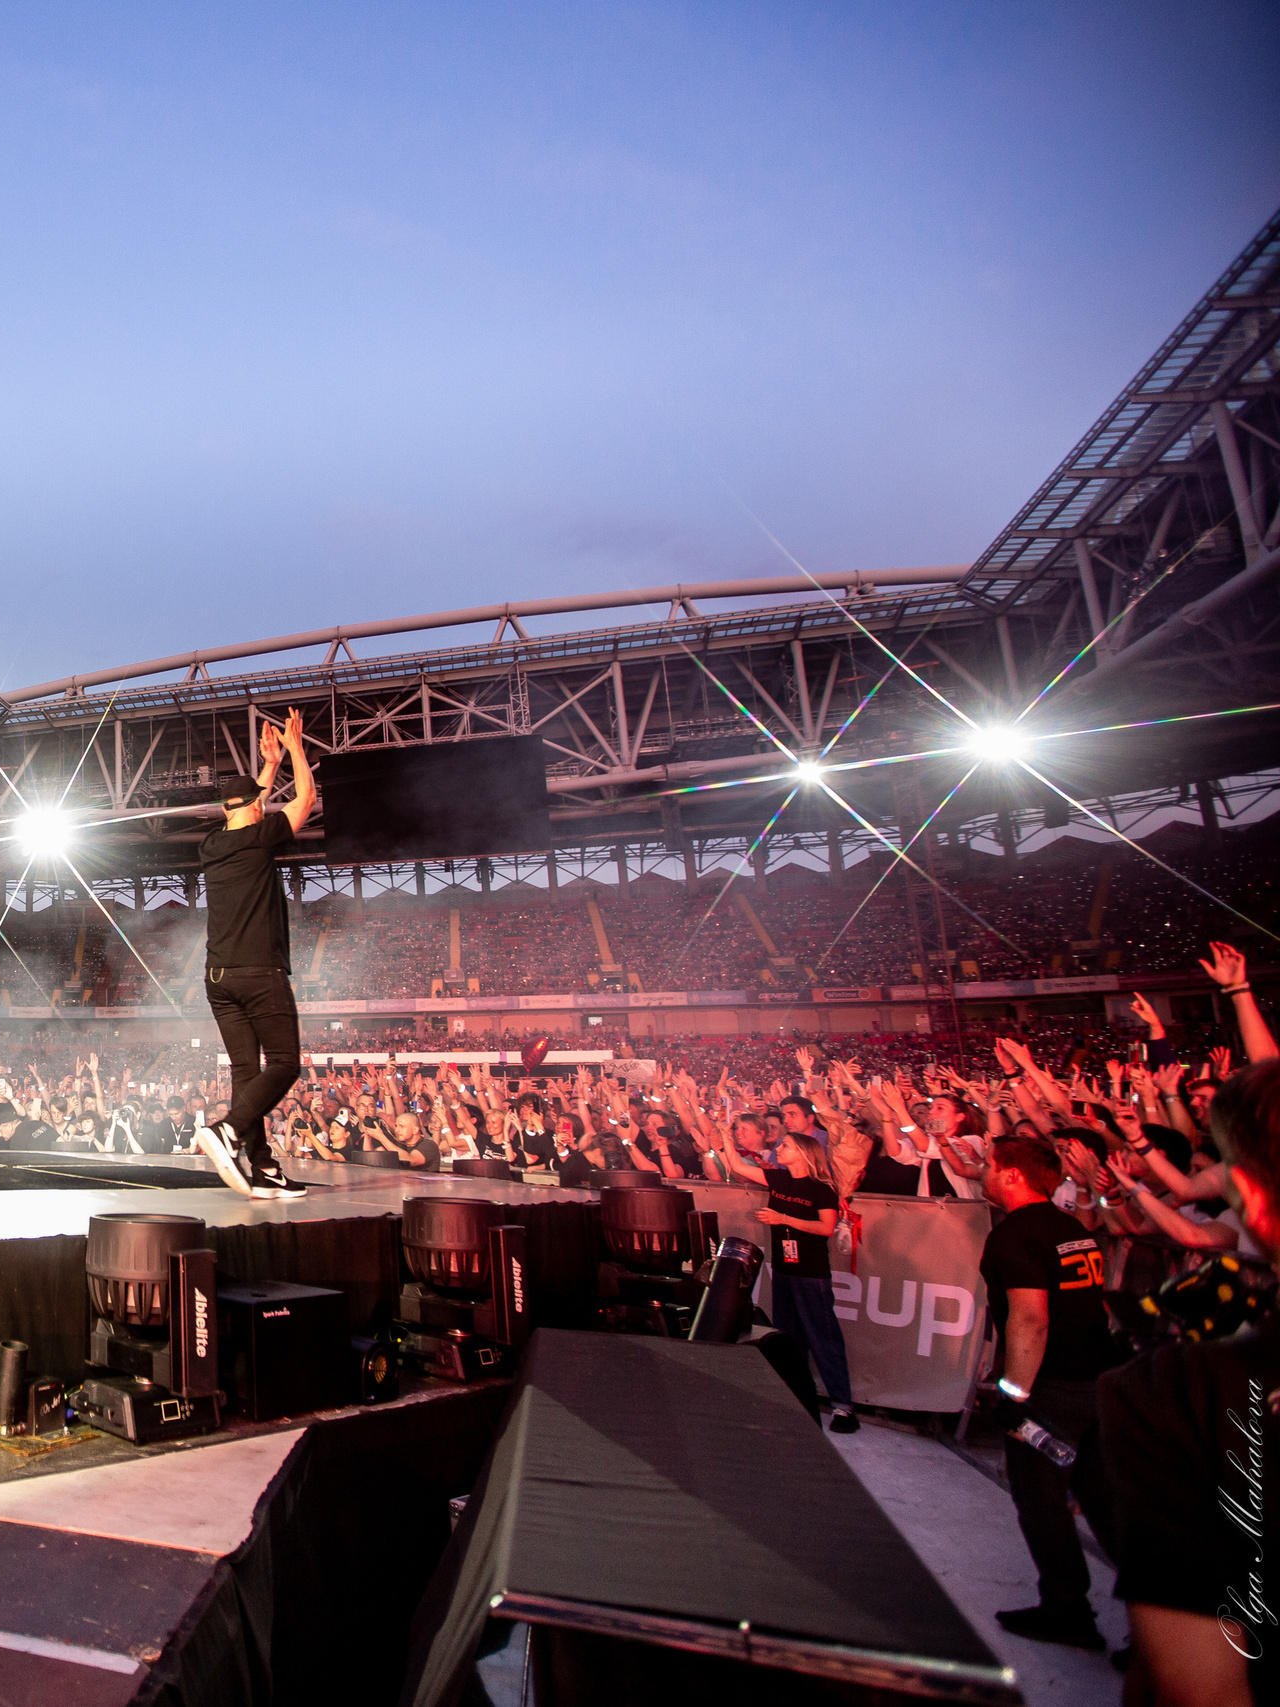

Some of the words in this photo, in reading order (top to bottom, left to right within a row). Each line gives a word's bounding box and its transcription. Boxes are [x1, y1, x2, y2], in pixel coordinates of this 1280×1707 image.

[825, 990, 858, 999] Winline
[511, 1256, 524, 1313] Ablelite
[1059, 1251, 1105, 1290] 30
[194, 1287, 209, 1358] Ablelite
